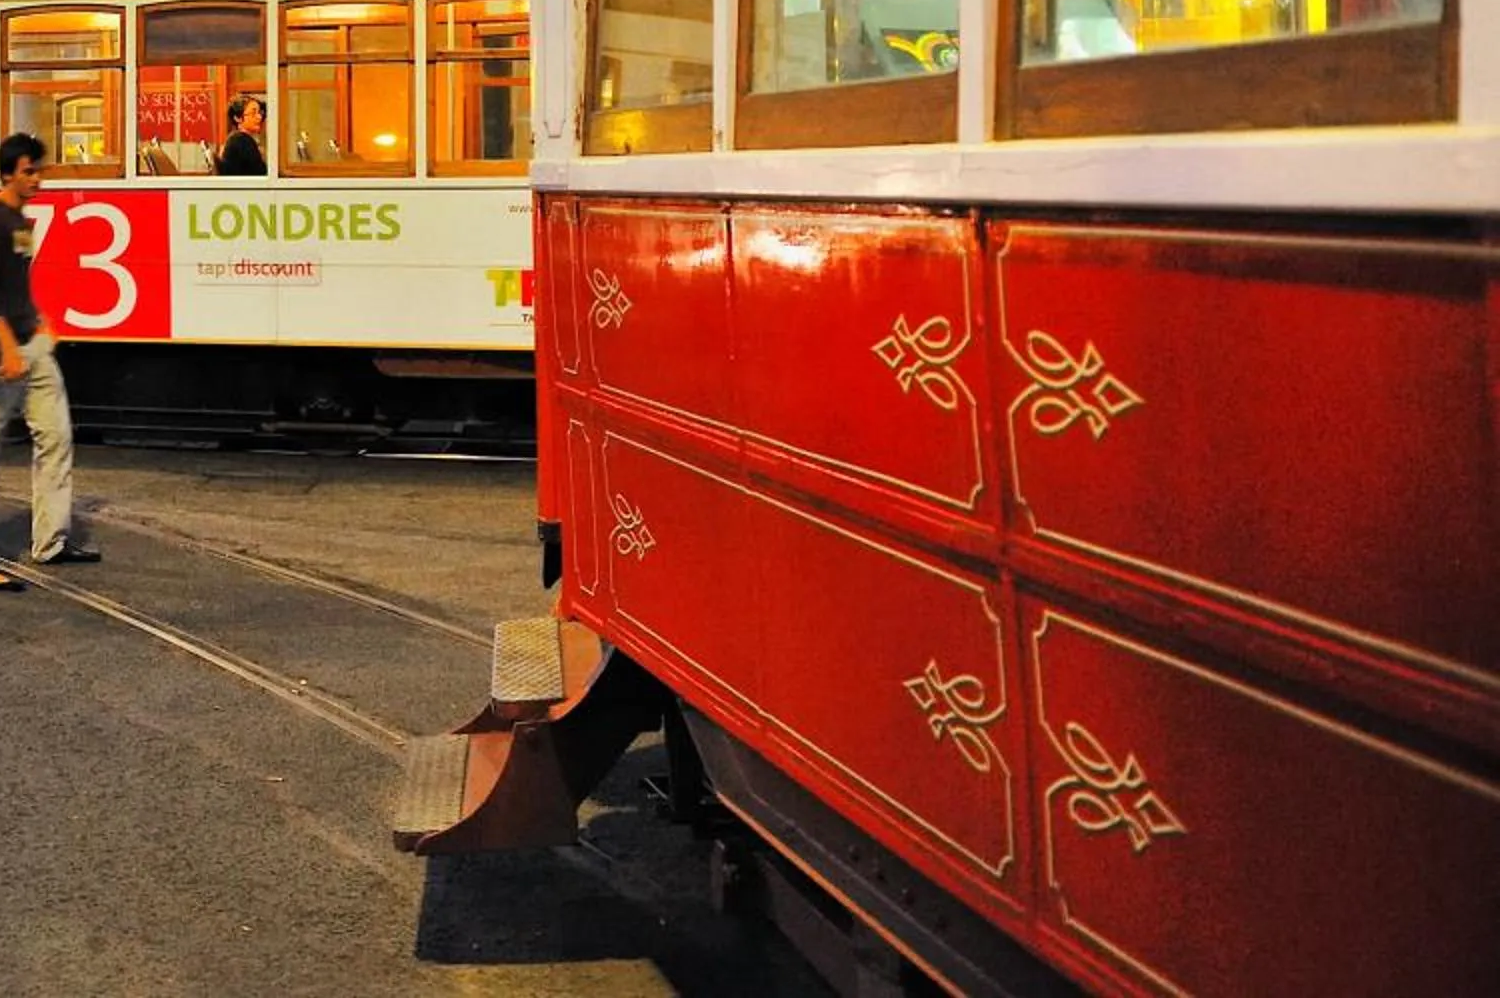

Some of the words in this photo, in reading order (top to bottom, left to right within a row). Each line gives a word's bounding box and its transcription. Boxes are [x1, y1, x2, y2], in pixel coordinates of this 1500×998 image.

[188, 203, 401, 241] LONDRES
[197, 261, 226, 277] tap
[233, 259, 313, 277] discount
